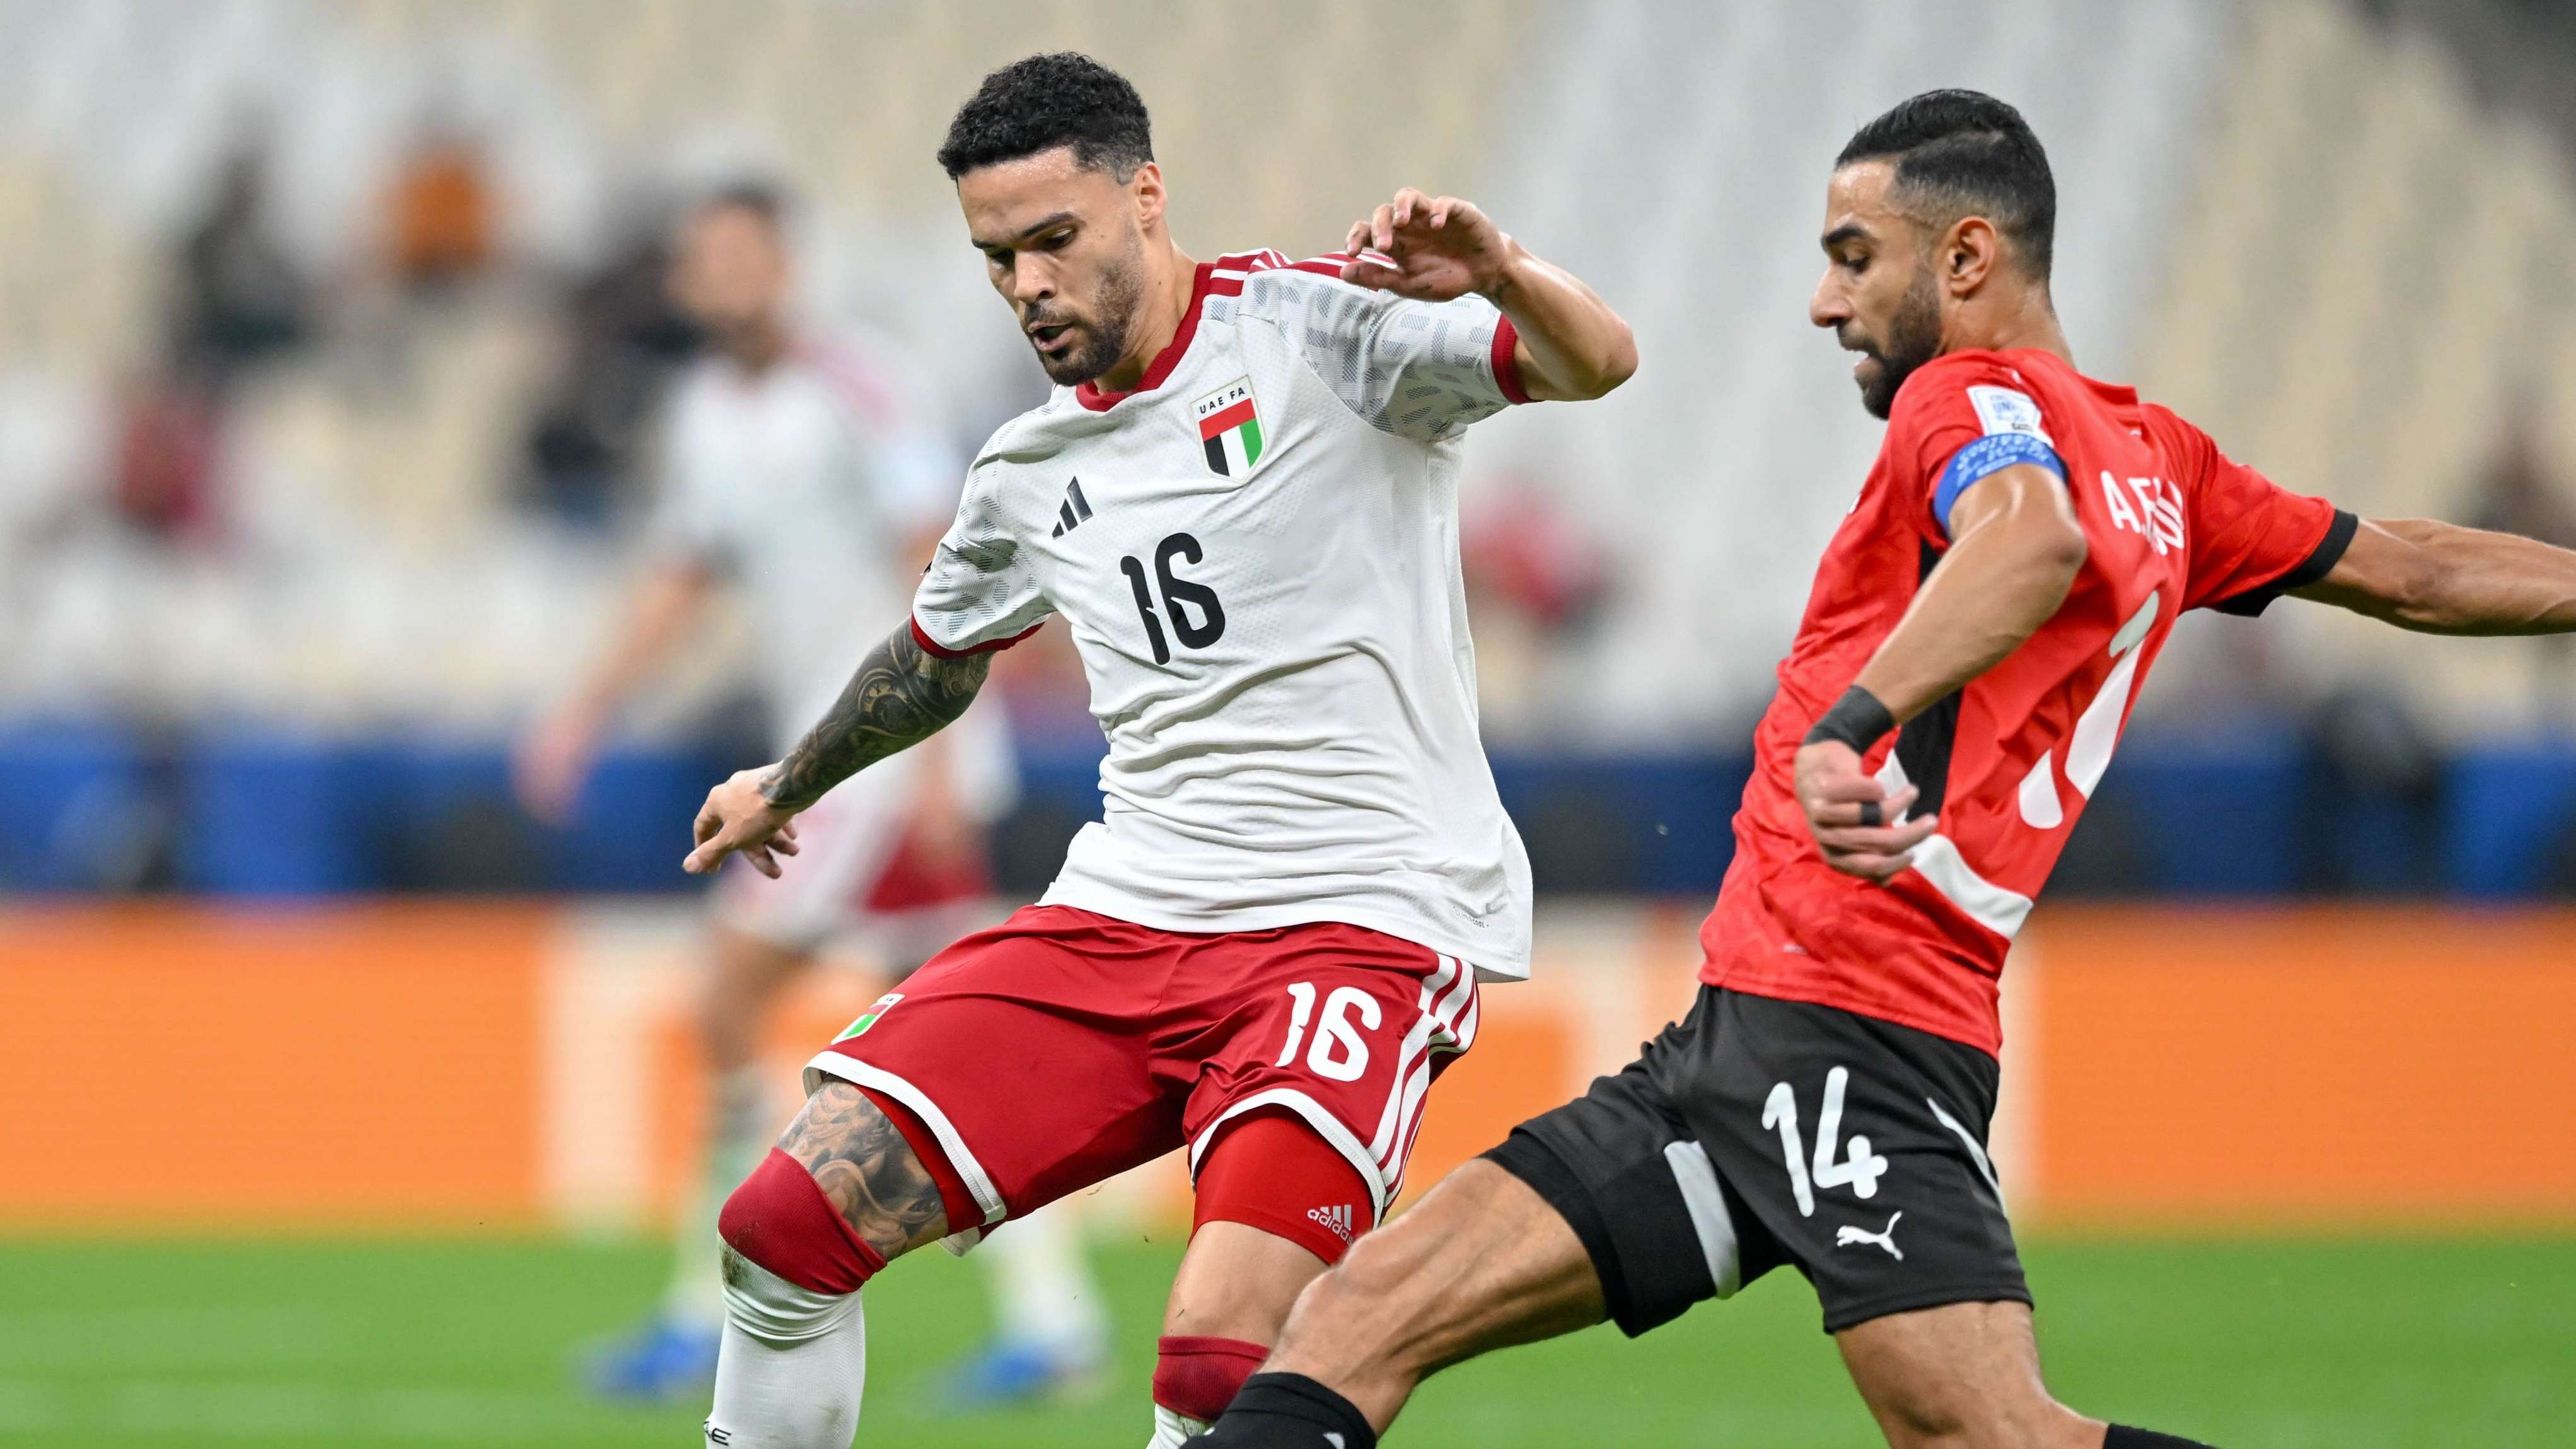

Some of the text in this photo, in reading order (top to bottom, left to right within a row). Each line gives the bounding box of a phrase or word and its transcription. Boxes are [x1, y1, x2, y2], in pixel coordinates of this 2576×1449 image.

[1199, 387, 1245, 414] UAE FA
[1120, 532, 1226, 665] 16
[1274, 981, 1382, 1082] 16
[1761, 1065, 1889, 1218] 14
[1307, 1209, 1353, 1247] adidas
